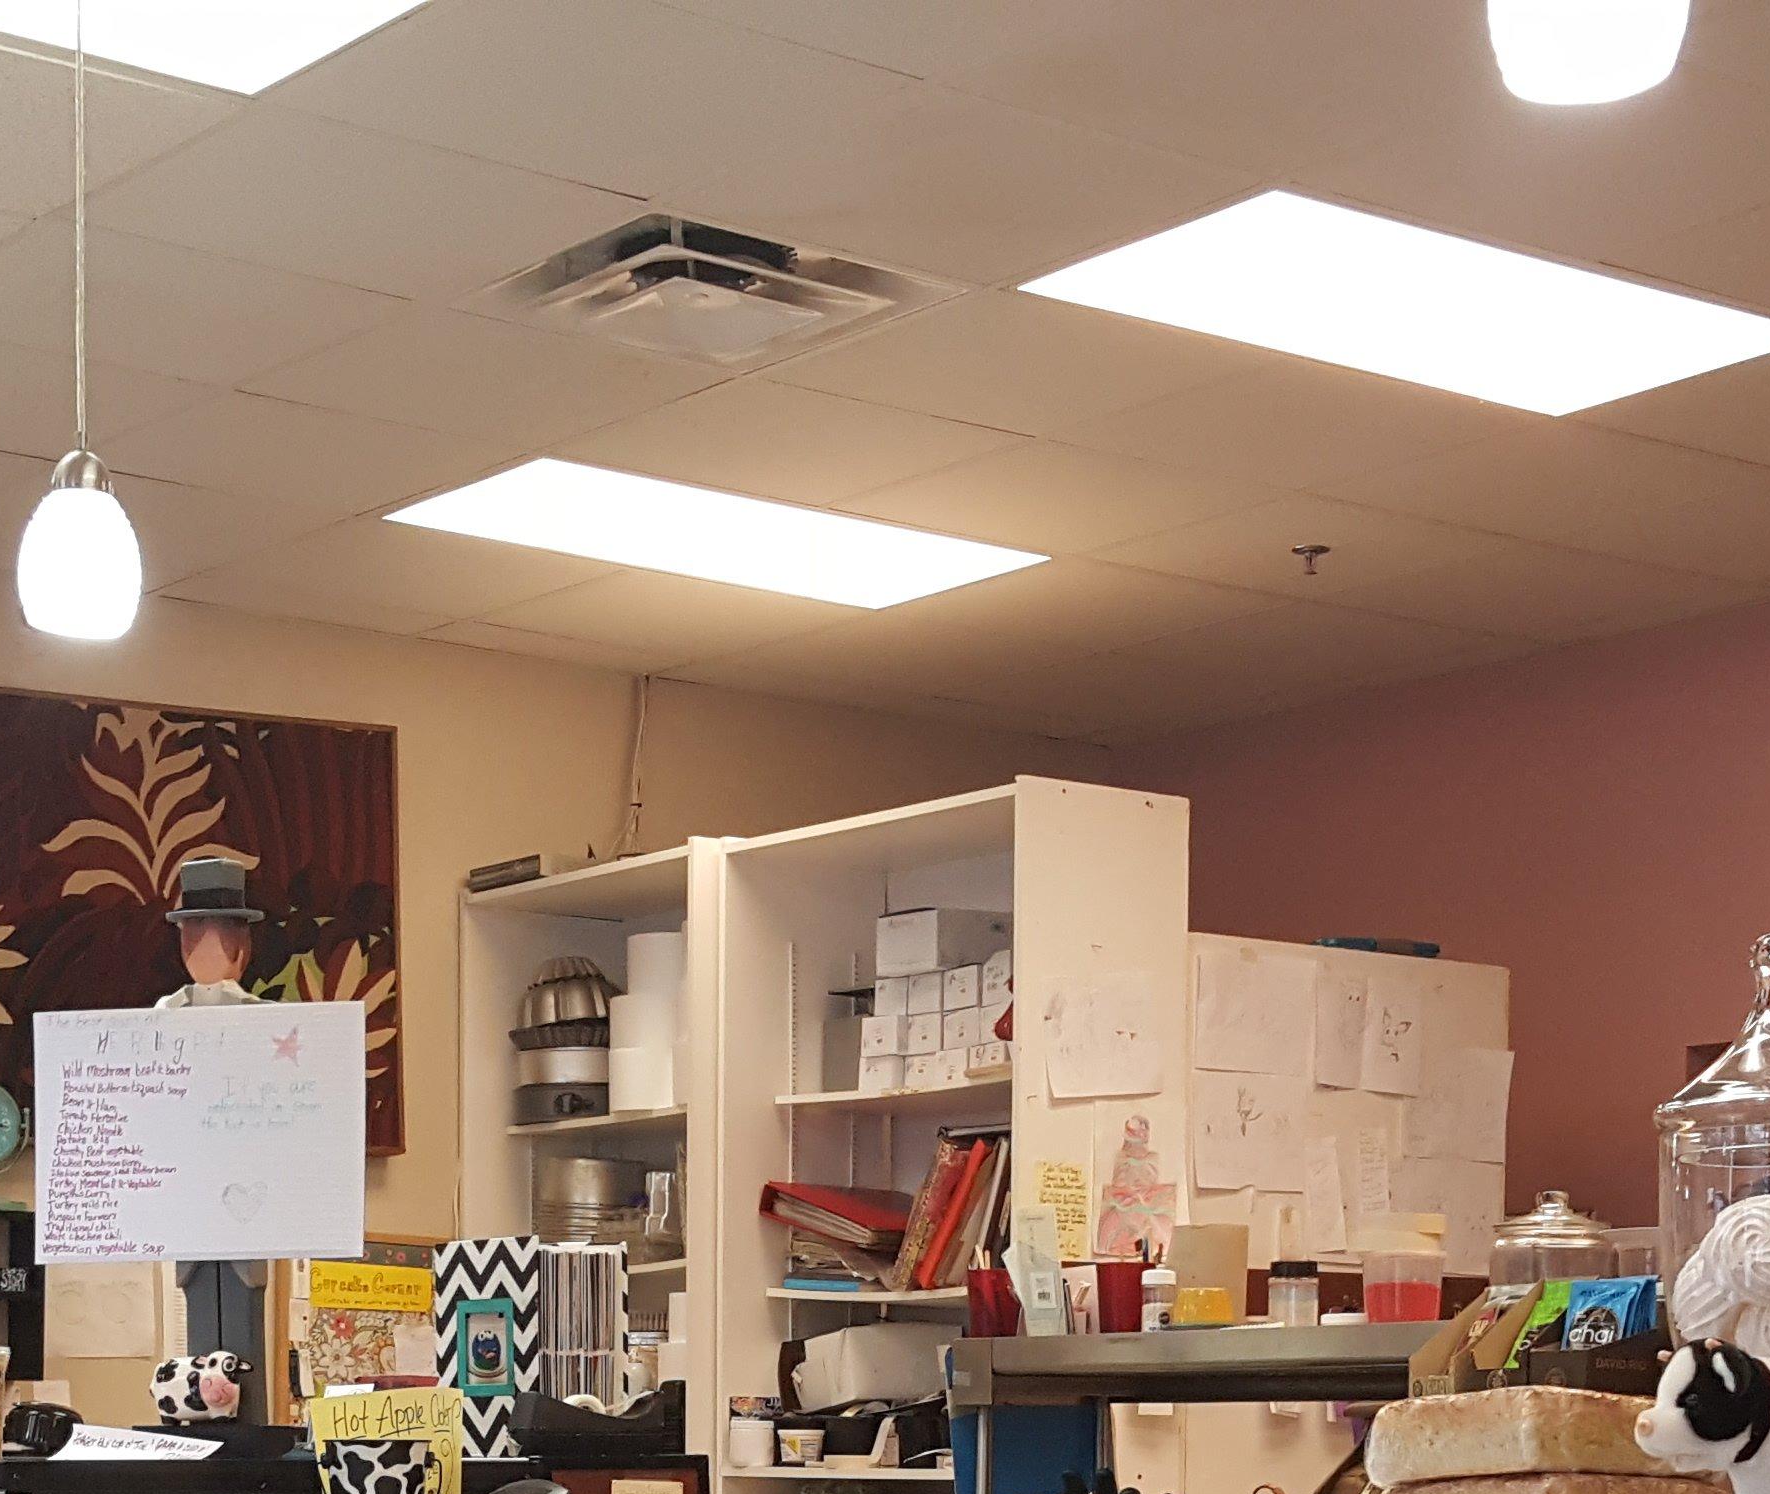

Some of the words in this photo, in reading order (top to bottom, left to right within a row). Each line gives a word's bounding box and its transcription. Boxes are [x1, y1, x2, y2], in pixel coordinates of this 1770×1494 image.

[61, 1059, 83, 1078] Wild
[58, 1121, 93, 1136] Chicken
[333, 1401, 368, 1437] Hot
[375, 1396, 426, 1435] Apple
